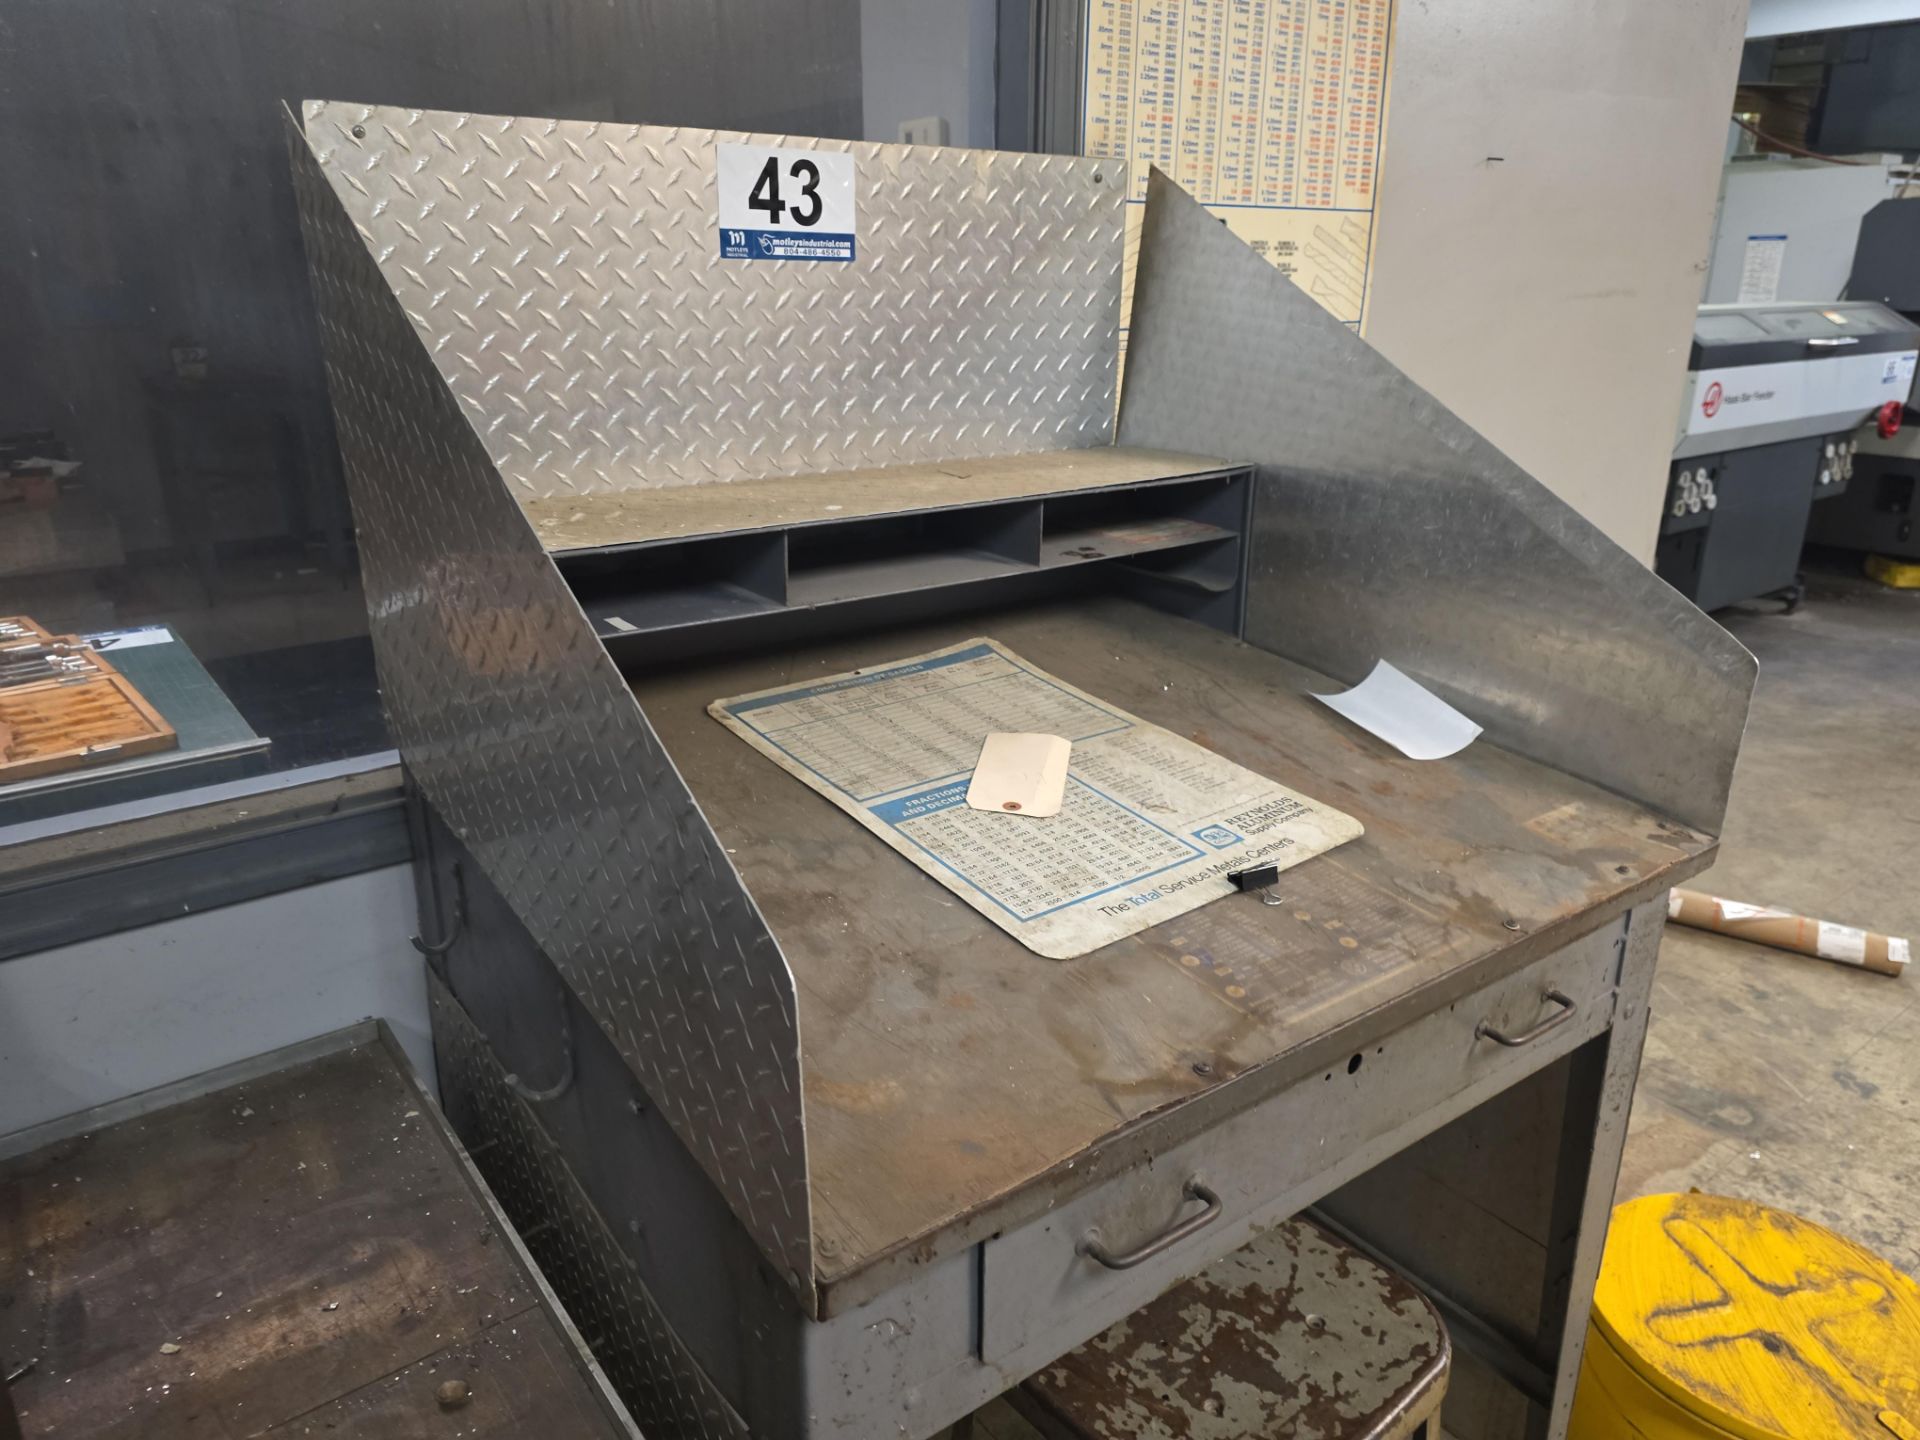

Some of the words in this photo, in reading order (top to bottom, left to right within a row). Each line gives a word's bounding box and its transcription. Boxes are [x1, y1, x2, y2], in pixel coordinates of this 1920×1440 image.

[748, 156, 823, 227] 43
[772, 236, 851, 249] motleysindustrial.com
[783, 247, 841, 257] 804-486-4550
[905, 785, 967, 807] FRACTIONS
[1224, 796, 1293, 825] REYNOLDS
[902, 805, 926, 817] AND
[1237, 801, 1303, 831] ALUMINUM
[1245, 819, 1278, 836] Supply
[1273, 807, 1314, 828] Company
[1097, 901, 1130, 918] The
[1124, 889, 1163, 907] Total
[1158, 870, 1211, 894] Service
[1206, 855, 1251, 876] Metals
[1245, 836, 1295, 859] Centers
